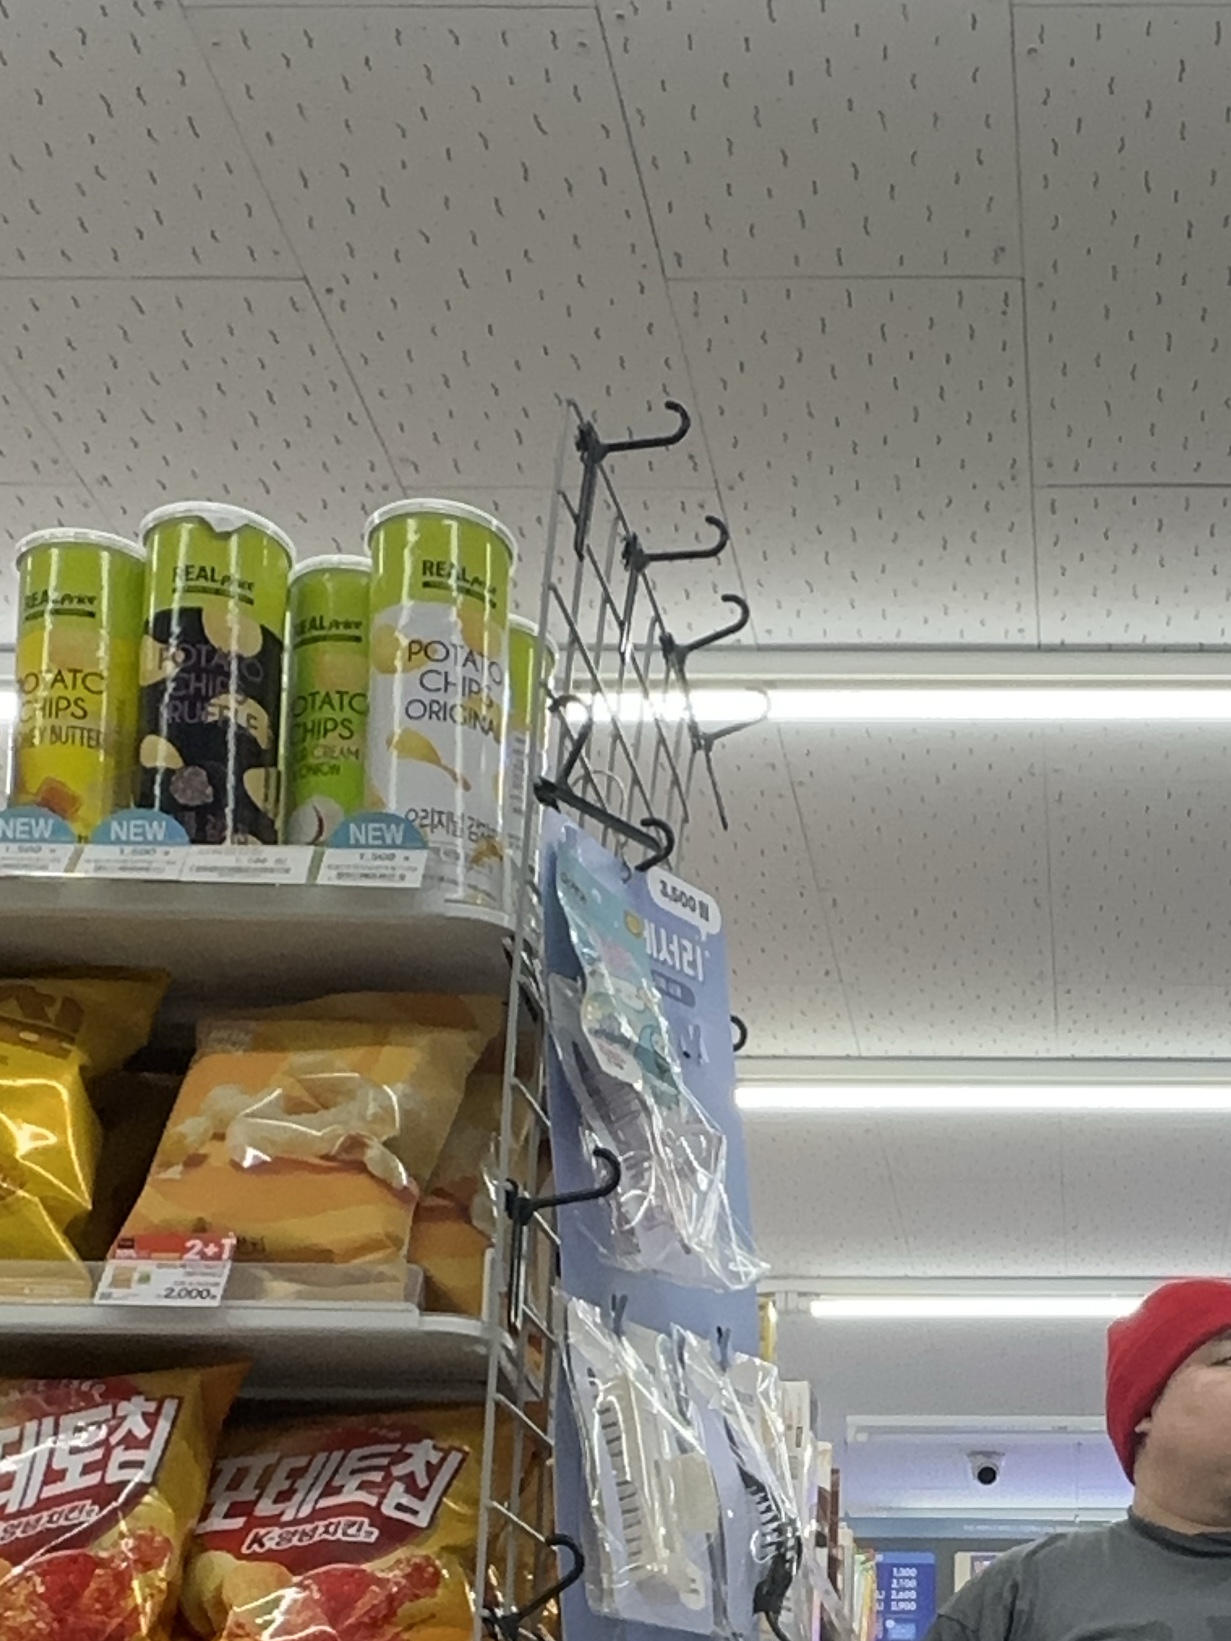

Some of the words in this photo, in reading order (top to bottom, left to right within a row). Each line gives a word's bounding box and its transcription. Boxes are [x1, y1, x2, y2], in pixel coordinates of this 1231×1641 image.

[405, 699, 498, 738] ORIGINA
[0, 817, 54, 840] NEW
[110, 820, 168, 842] NEW
[349, 822, 406, 846] NEW
[184, 1232, 237, 1260] 2+1
[195, 1439, 462, 1536] 포테토칩
